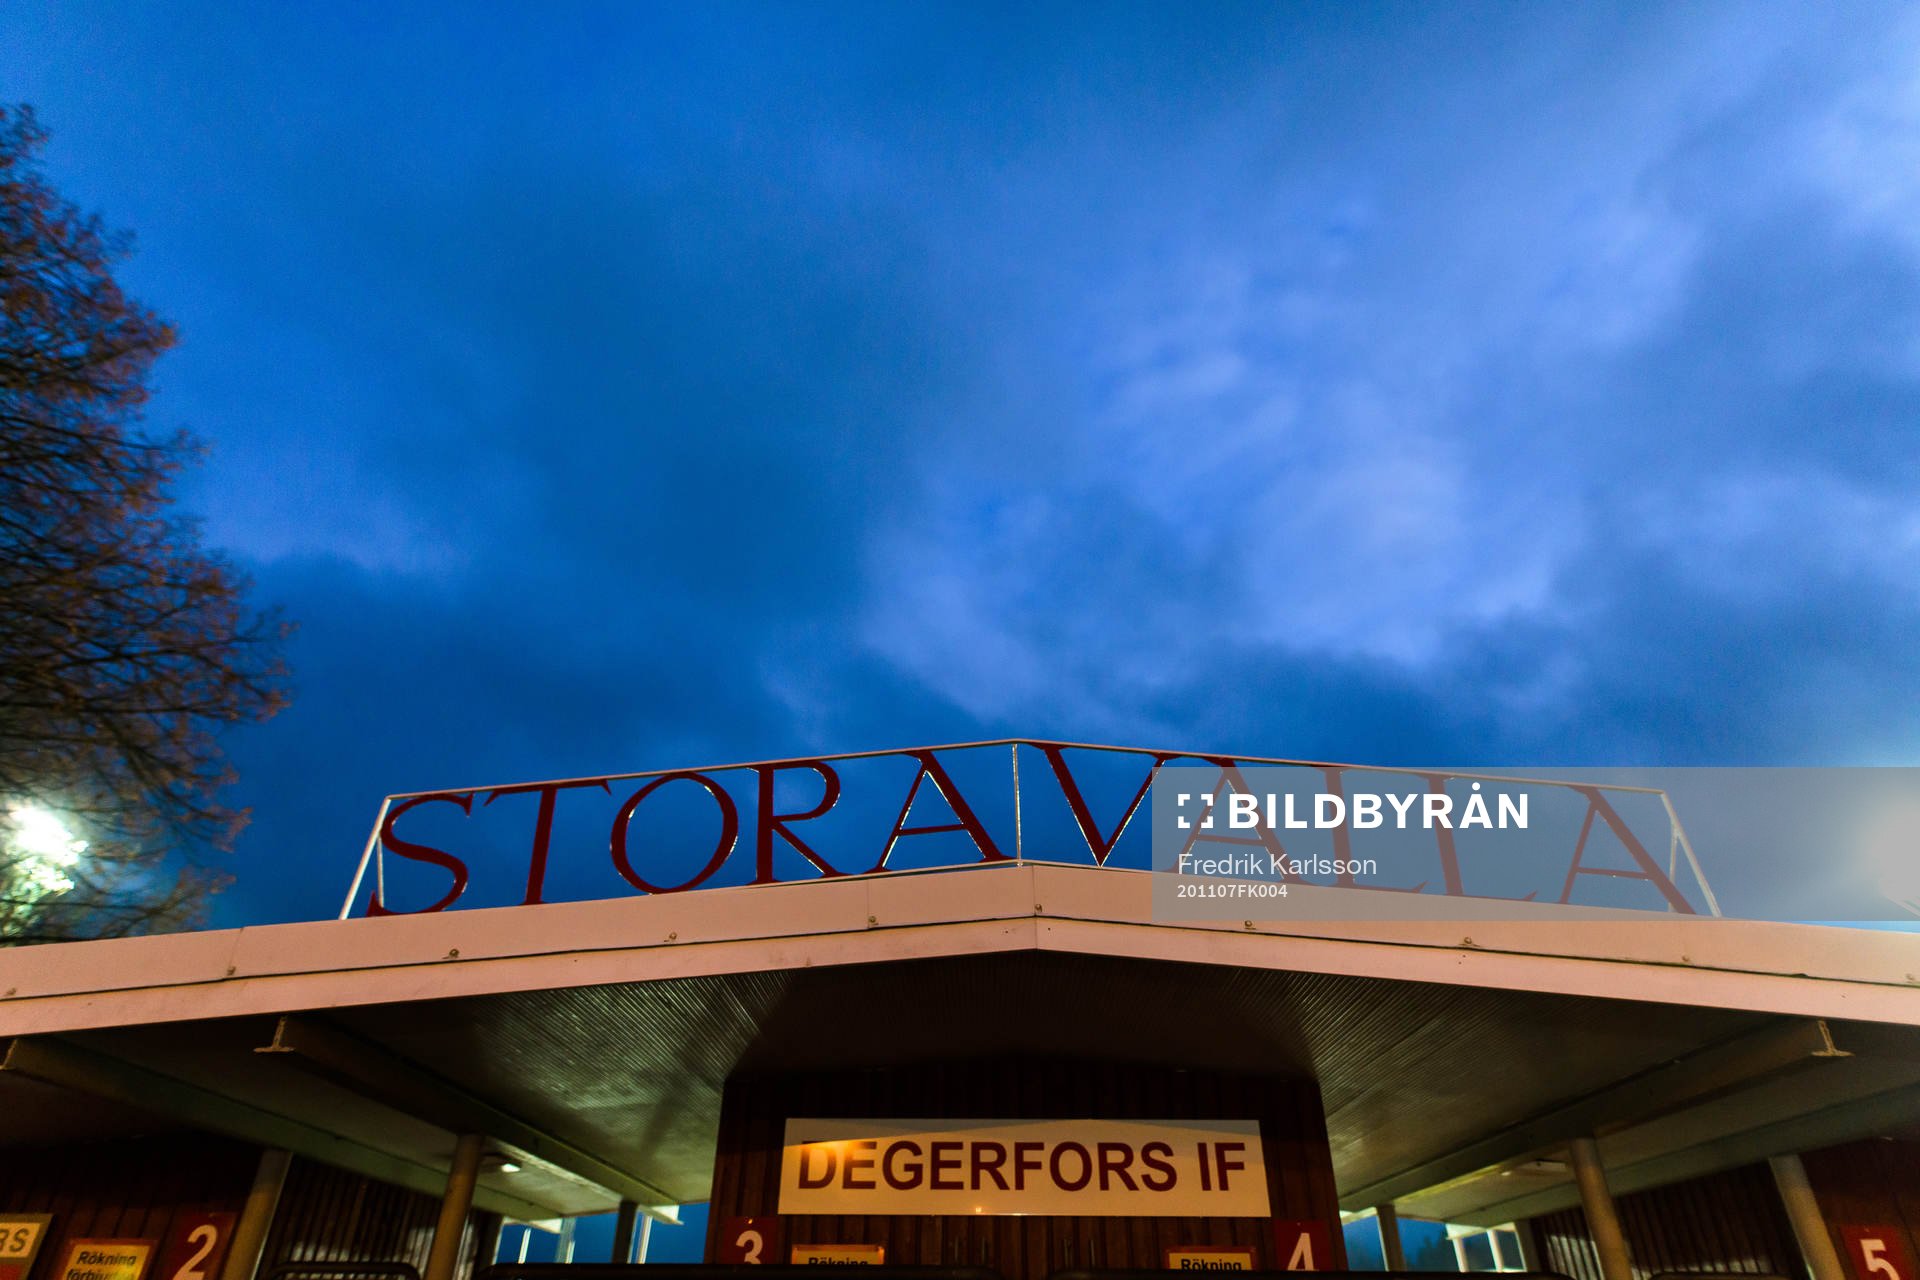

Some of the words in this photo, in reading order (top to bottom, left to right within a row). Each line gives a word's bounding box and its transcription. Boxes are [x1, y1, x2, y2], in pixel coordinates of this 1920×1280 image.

[366, 748, 1018, 917] STORA
[1023, 740, 1702, 917] VALLA
[798, 1140, 1178, 1192] DEGERFORS
[1197, 1141, 1246, 1192] IF
[172, 1224, 218, 1280] 2
[1860, 1238, 1900, 1280] 5
